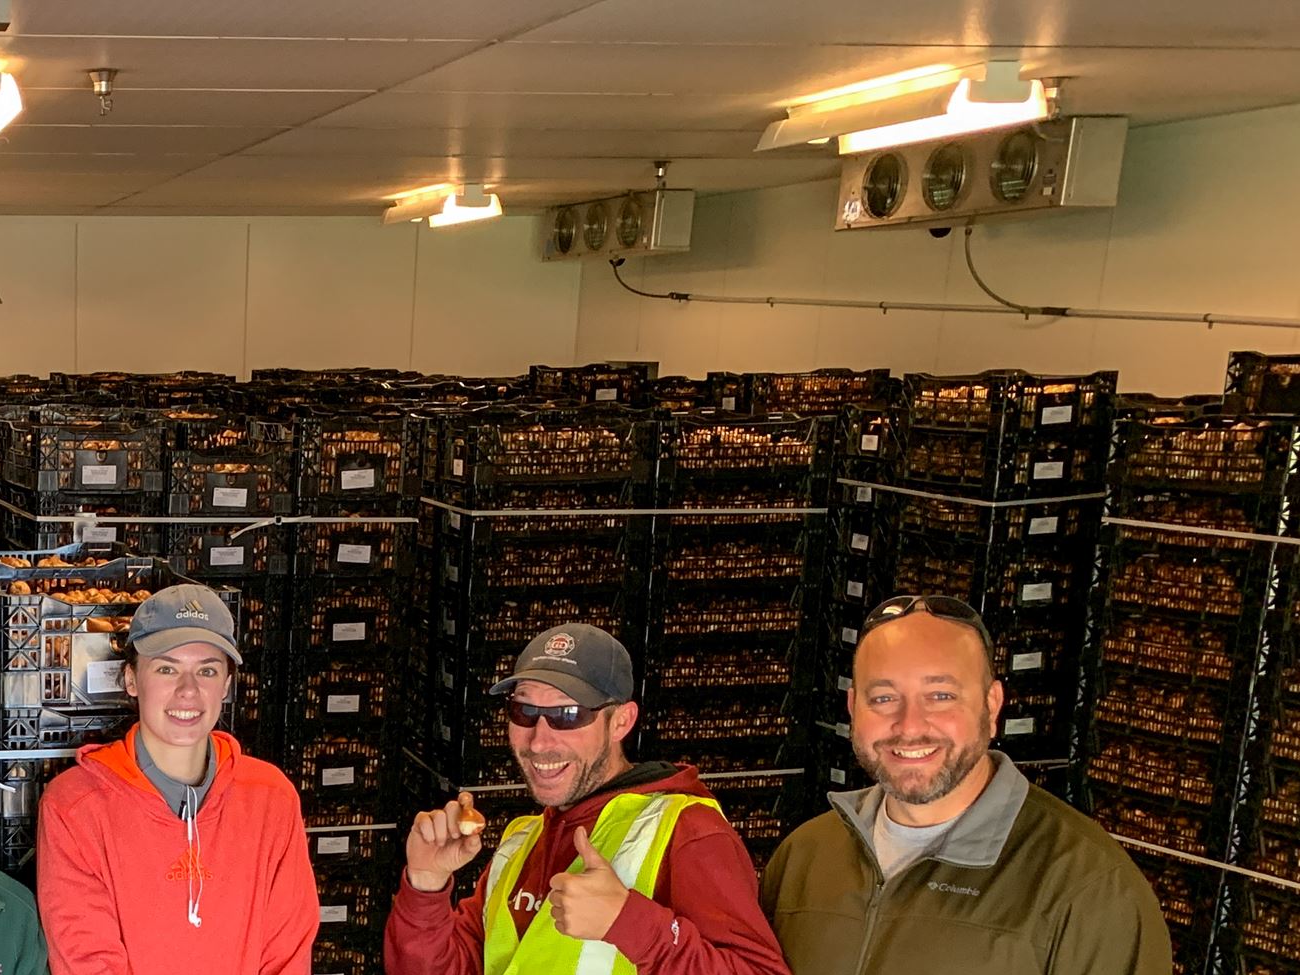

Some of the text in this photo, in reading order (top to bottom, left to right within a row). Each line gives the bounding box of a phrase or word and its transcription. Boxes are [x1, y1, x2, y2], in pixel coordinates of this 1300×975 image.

[175, 610, 209, 621] adidas
[165, 870, 214, 881] adidas
[939, 883, 981, 897] Columbia
